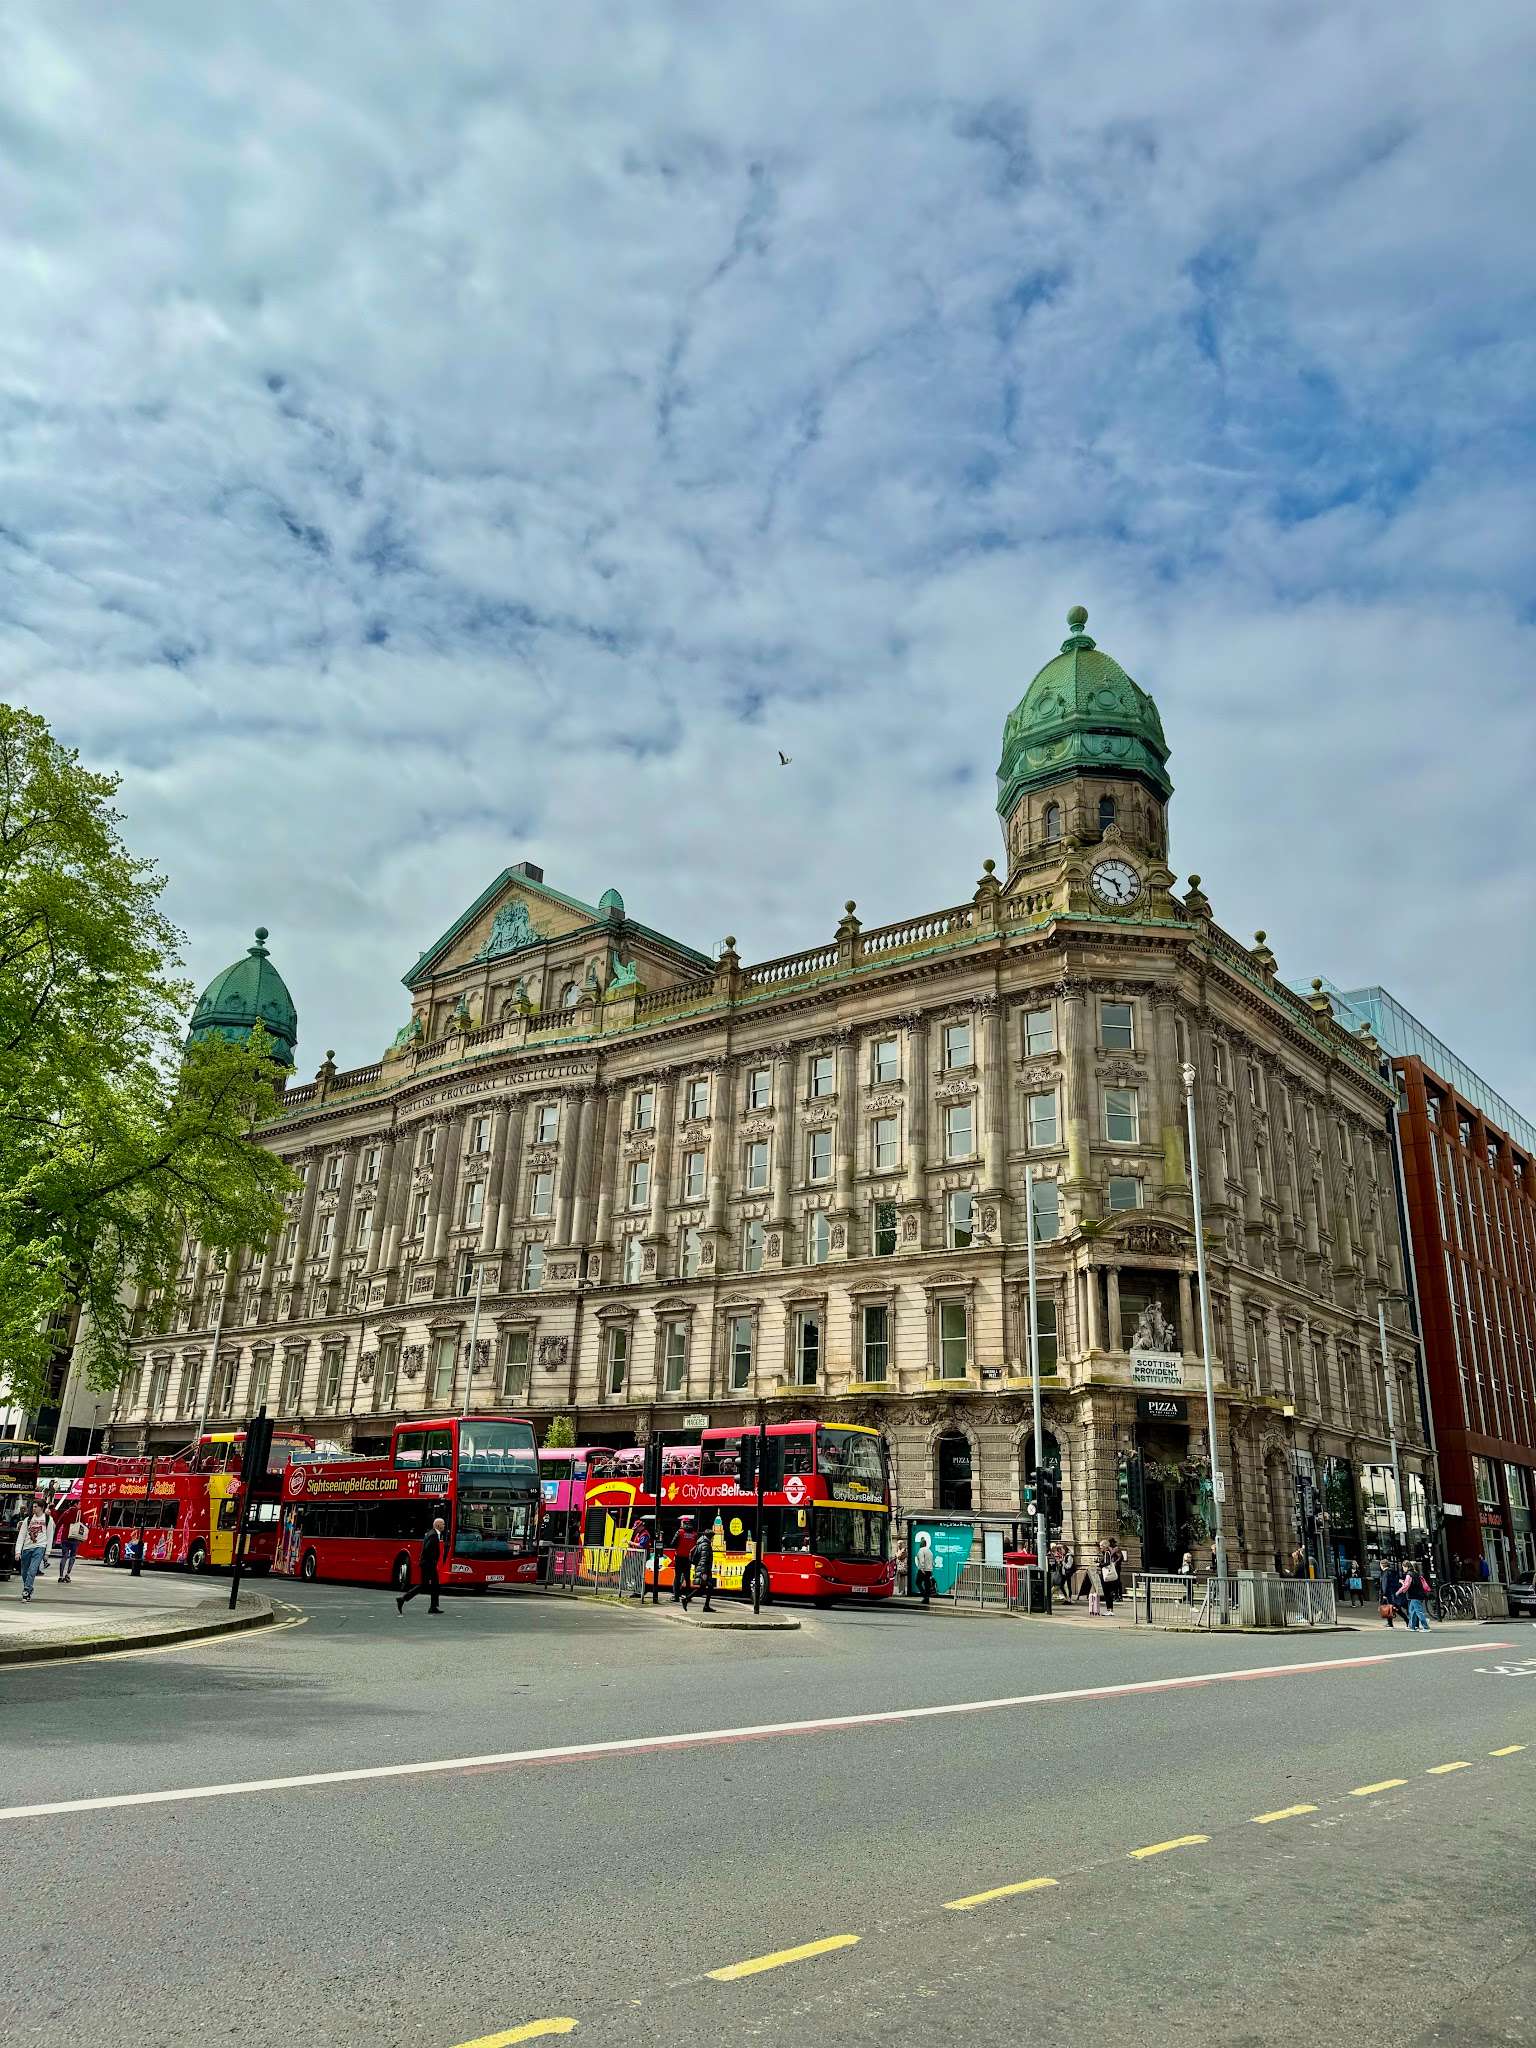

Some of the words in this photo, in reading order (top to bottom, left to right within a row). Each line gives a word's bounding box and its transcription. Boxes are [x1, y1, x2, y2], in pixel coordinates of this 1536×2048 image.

[400, 1093, 437, 1116] SCOTTISH
[441, 1079, 497, 1100] PROVIDENT
[1136, 1360, 1176, 1369] SCOTTISH
[1134, 1367, 1179, 1377] PROVIDENT
[1132, 1375, 1182, 1385] INSTITUTION
[1148, 1401, 1178, 1412] PIZZA
[952, 1456, 970, 1464] PIZZA
[306, 1476, 398, 1495] SightseeingBelfast.com
[833, 1490, 883, 1503] CityToursBelfast
